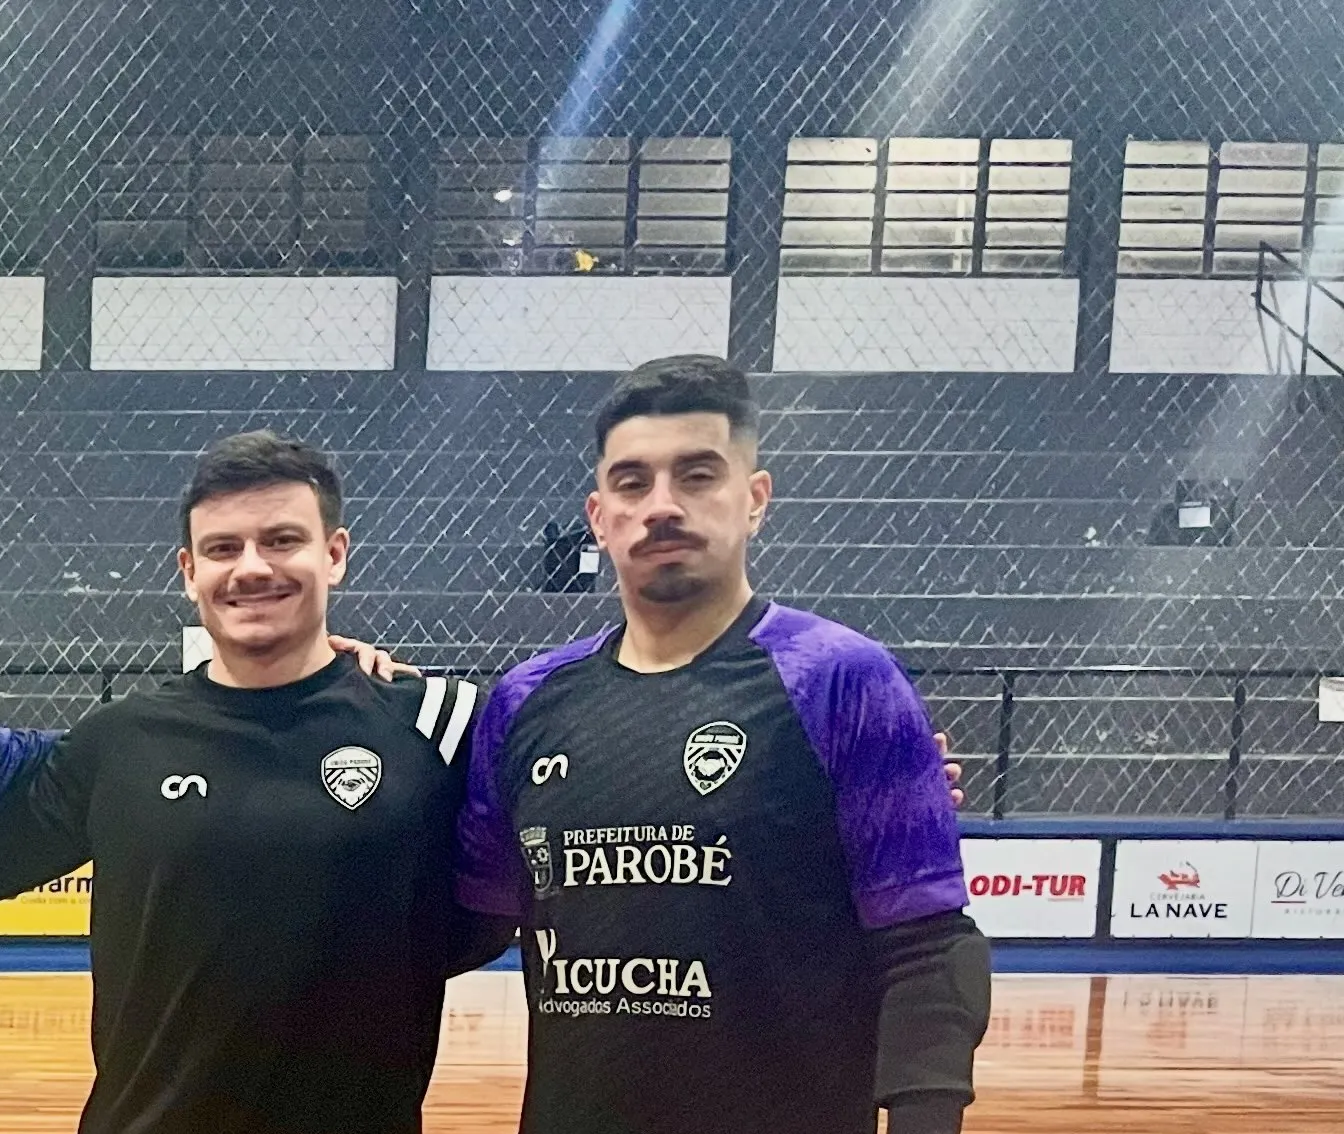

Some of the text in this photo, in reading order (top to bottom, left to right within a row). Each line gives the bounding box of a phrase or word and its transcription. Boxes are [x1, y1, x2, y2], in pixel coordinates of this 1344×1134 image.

[563, 825, 695, 846] PREFEITURA DE
[563, 834, 732, 887] PAROBÉ
[969, 874, 1086, 897] ODI-TUR
[1131, 903, 1228, 919] LA NAVE
